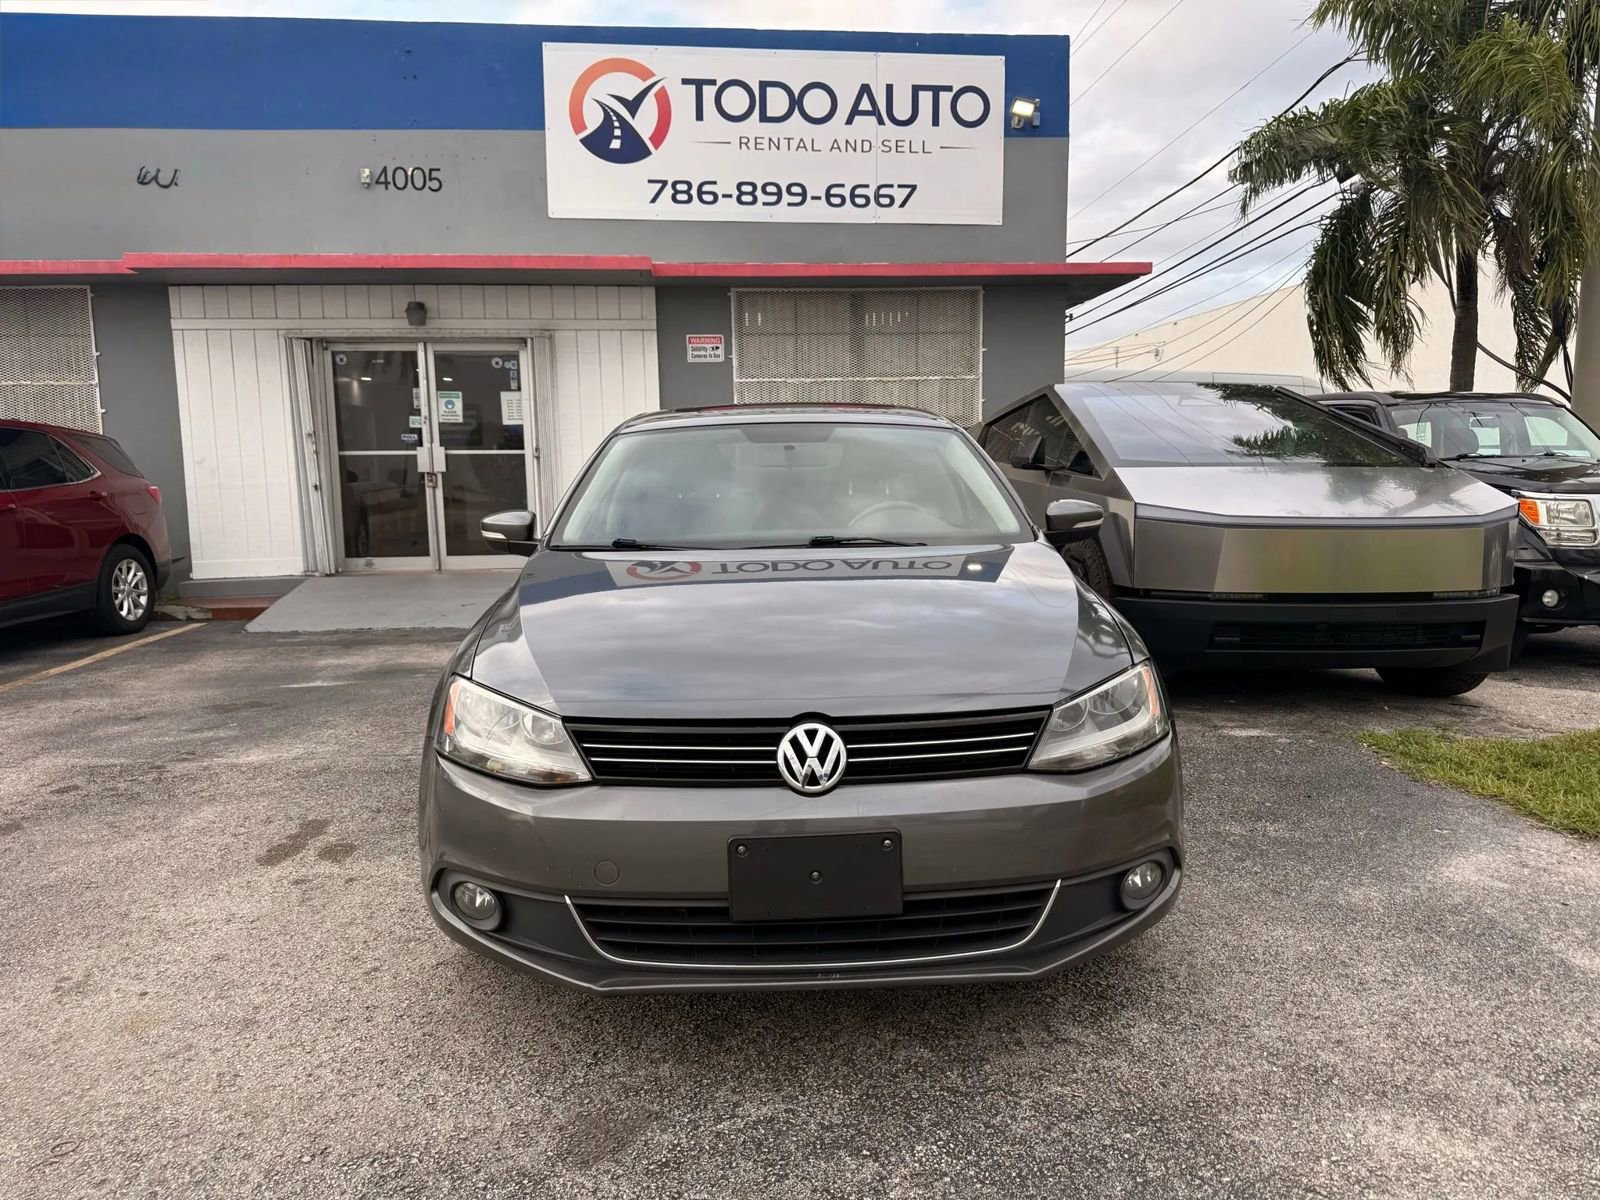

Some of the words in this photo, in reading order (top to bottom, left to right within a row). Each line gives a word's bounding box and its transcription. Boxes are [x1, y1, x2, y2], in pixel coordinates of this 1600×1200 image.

[681, 78, 838, 125] TODO
[845, 84, 990, 128] AUTO
[738, 136, 821, 152] RENTAL
[830, 139, 873, 153] AND
[881, 139, 932, 154] SELL
[374, 166, 442, 192] 4005
[647, 179, 917, 208] 786-899-6667
